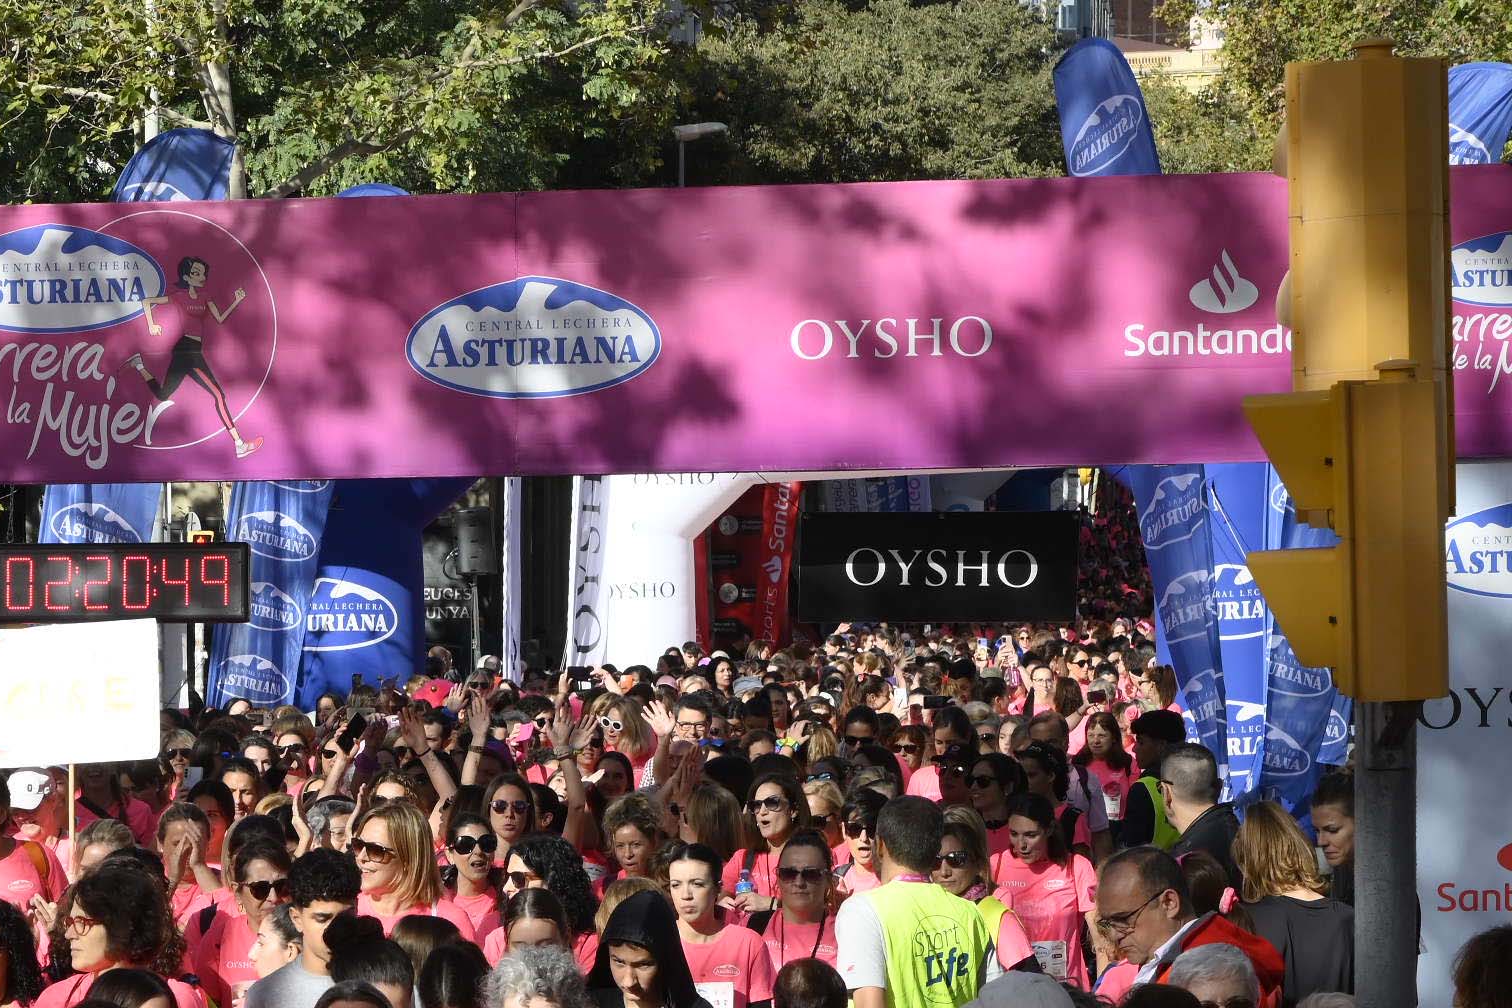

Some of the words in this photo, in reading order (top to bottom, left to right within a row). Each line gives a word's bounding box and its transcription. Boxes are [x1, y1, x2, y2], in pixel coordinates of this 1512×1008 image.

[68, 261, 140, 272] LECHERA
[465, 320, 544, 332] CENTRAL
[552, 317, 633, 329] LECHERA
[791, 315, 993, 361] OYSHO
[426, 324, 641, 368] ASTURIANA
[7, 384, 31, 424] la
[27, 376, 175, 470] Mujer
[238, 523, 310, 555] ASTURIANA
[6, 555, 228, 610] 02:20:49
[845, 547, 1039, 588] OYSHO
[332, 602, 384, 612] LECHERA
[1417, 687, 1512, 730] OY
[925, 947, 970, 987] Life
